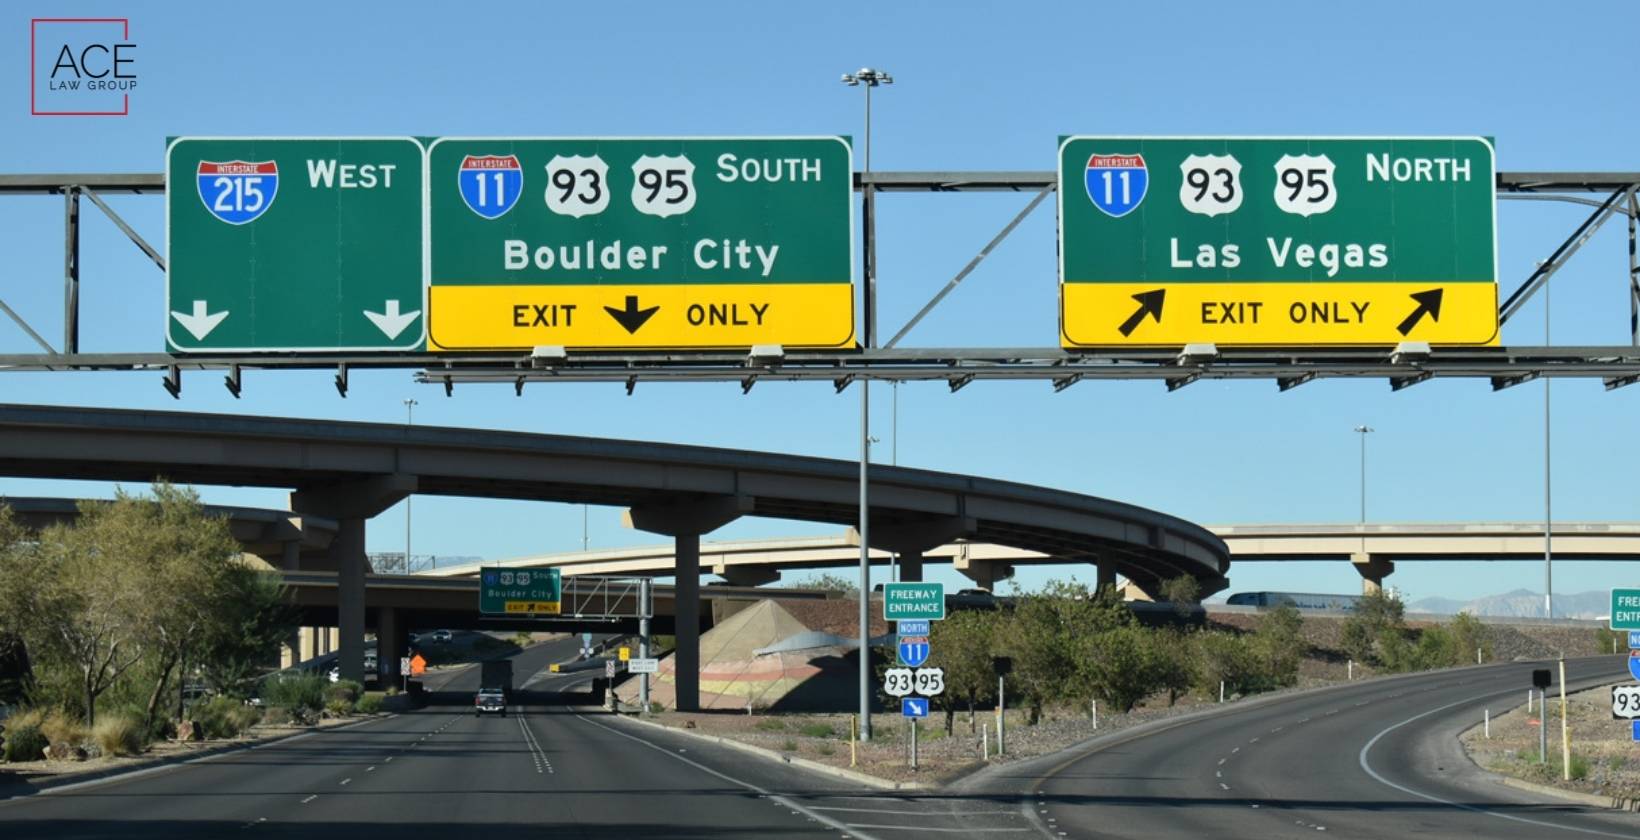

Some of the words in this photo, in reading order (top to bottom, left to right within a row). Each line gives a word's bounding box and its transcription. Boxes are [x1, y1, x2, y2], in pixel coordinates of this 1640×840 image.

[217, 164, 258, 173] INTERSTATE
[468, 160, 512, 168] INTERSTATE
[1095, 158, 1137, 167] INTERSTATE
[307, 159, 396, 188] WEST
[476, 172, 504, 207] 11
[552, 168, 601, 204] 93
[638, 168, 689, 204] 95
[717, 154, 821, 182] SOUTH
[1102, 171, 1130, 205] 11
[1187, 168, 1235, 203] 93
[1281, 168, 1329, 203] 95
[1366, 153, 1470, 181] NORTH
[213, 176, 264, 212] 215
[505, 240, 667, 270] Boulder
[694, 239, 779, 276] City
[1170, 238, 1240, 268] Las
[1267, 238, 1389, 277] Vegas
[513, 304, 576, 327] EXIT
[687, 303, 769, 326] ONLY
[1201, 302, 1263, 324] EXIT
[1290, 301, 1370, 324] ONLY
[488, 590, 526, 598] Boulder
[531, 590, 552, 599] City
[890, 589, 937, 600] FREEWAY
[1618, 596, 1640, 607] FRE
[889, 603, 939, 613] ENTRANCE
[900, 623, 928, 633] NORTH
[907, 644, 922, 661] 11
[888, 674, 909, 690] 93
[919, 673, 940, 690] 95
[1618, 693, 1640, 711] 93
